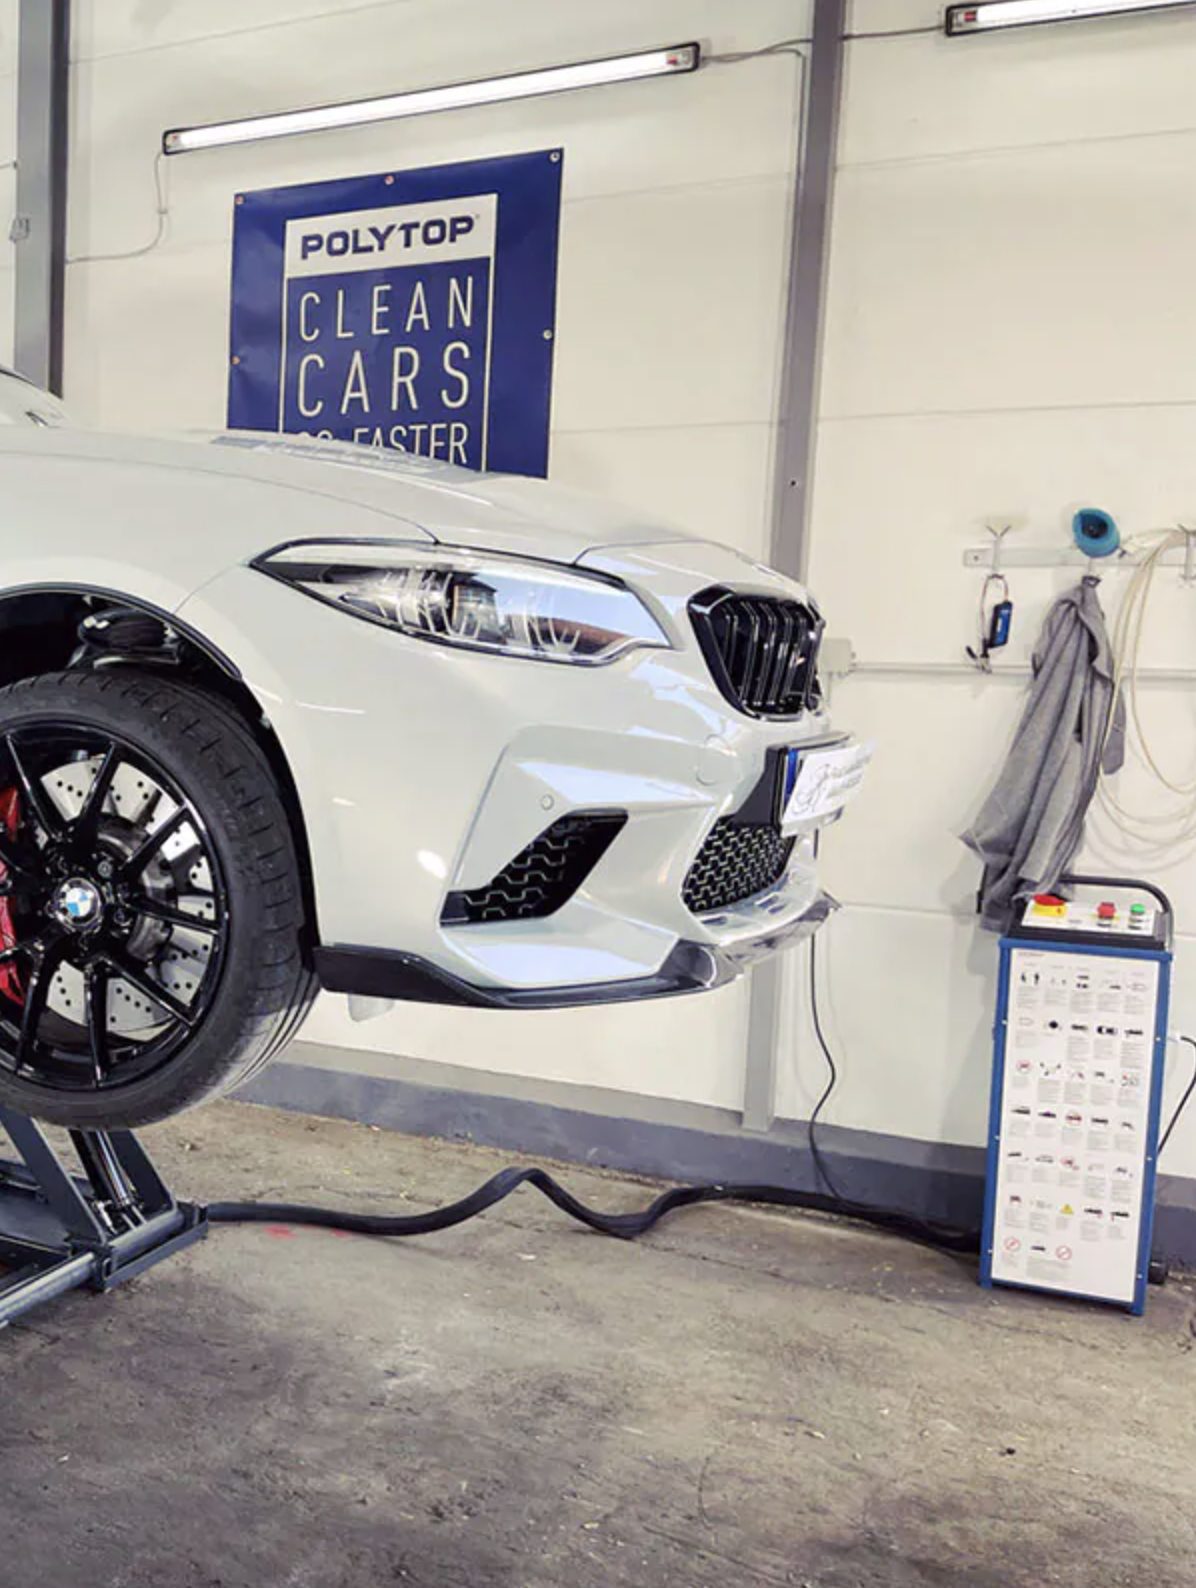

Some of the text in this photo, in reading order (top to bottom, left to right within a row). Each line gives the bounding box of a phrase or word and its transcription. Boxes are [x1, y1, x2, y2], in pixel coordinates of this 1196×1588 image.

[301, 215, 475, 260] POLYTOP
[299, 275, 474, 341] CLEAN
[297, 341, 471, 417] CARS
